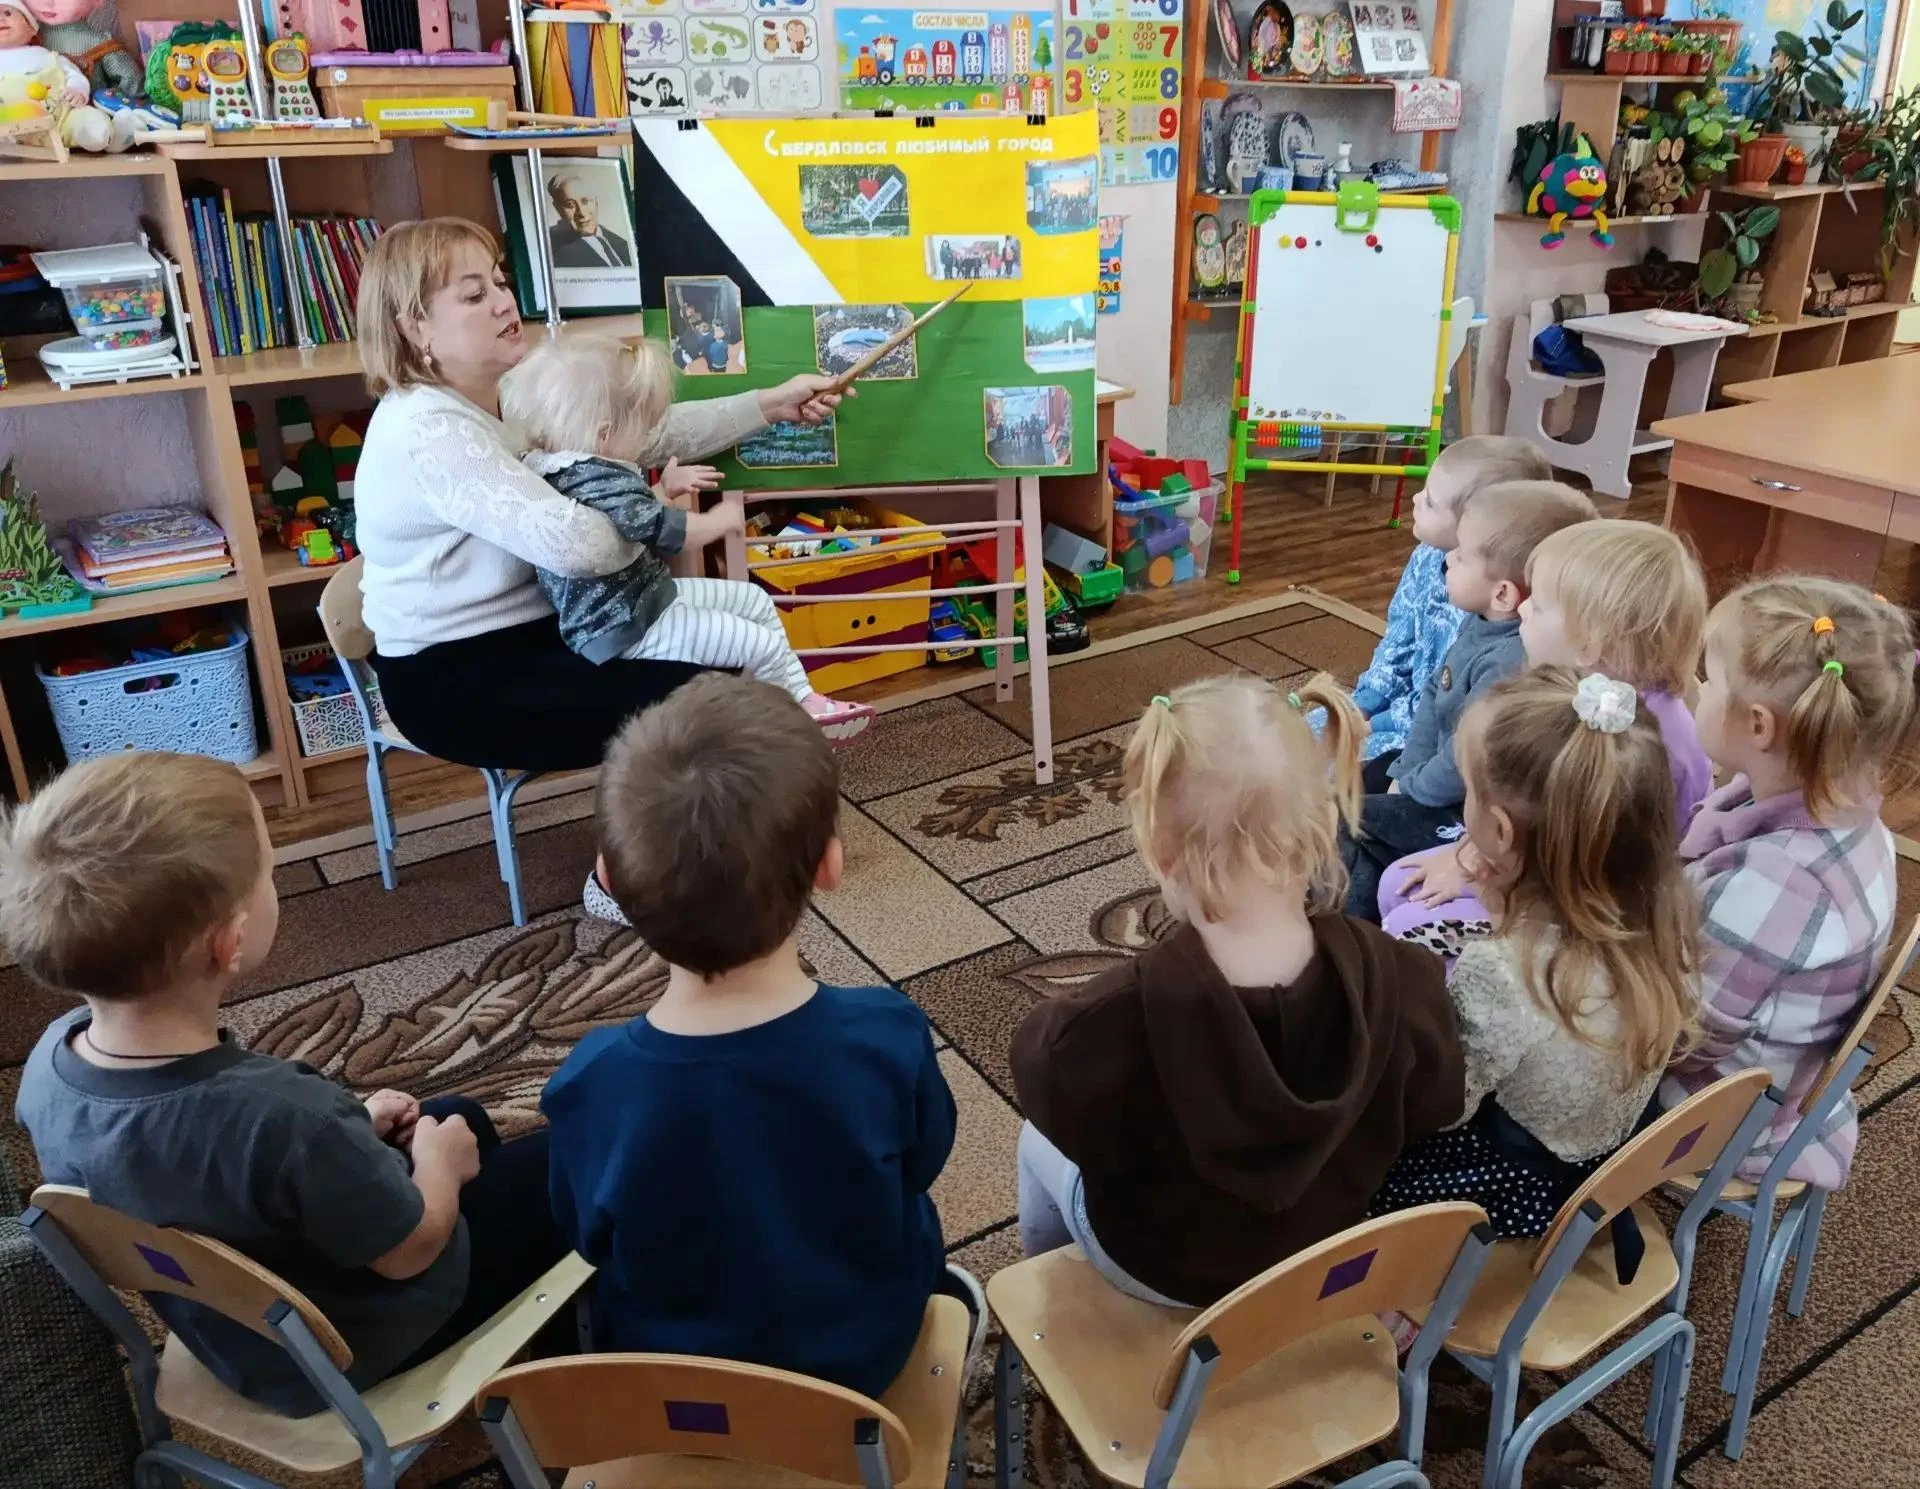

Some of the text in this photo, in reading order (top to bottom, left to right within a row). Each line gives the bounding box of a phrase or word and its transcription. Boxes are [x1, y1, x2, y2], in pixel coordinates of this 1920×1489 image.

[1066, 26, 1083, 59] 2
[1160, 26, 1179, 58] 7
[1066, 69, 1082, 103] 3
[1160, 67, 1179, 99] 8
[1159, 107, 1178, 140] 9
[764, 128, 1054, 157] СВЕРДЛОВСК ЛЮБИМЫЙ ГОРОД
[1146, 147, 1178, 178] 10
